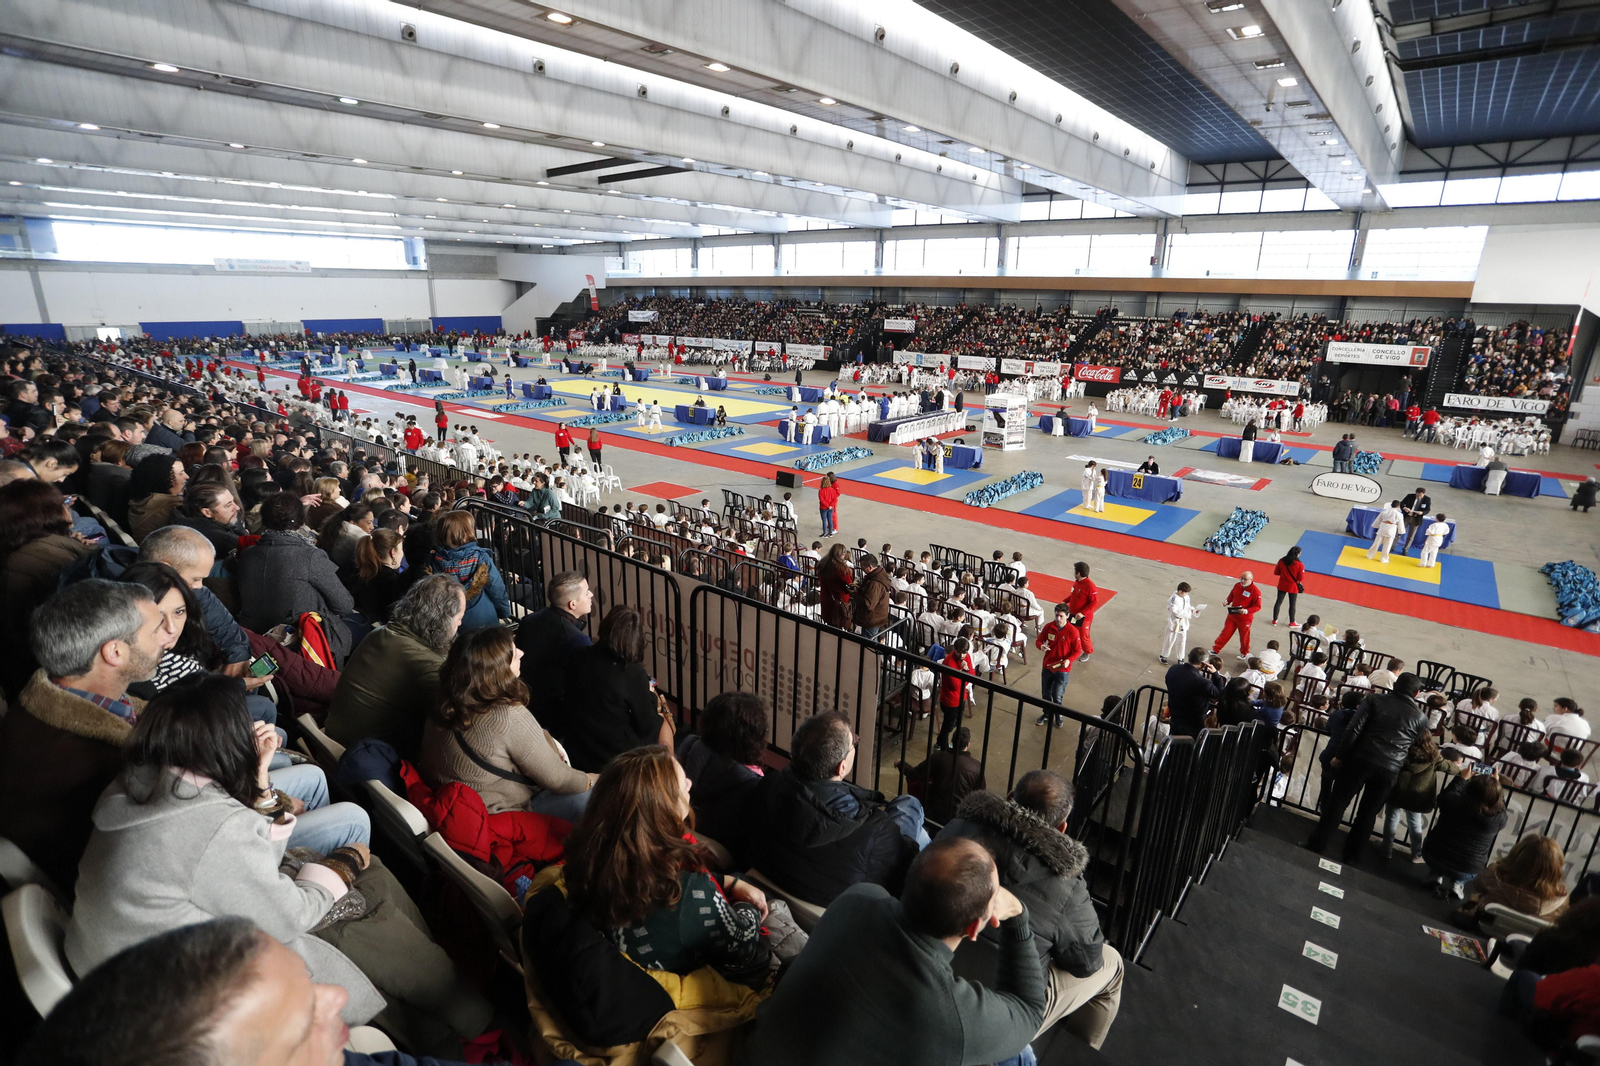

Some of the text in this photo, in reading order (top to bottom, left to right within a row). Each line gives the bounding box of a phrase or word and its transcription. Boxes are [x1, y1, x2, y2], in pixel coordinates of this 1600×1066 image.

[1078, 366, 1116, 381] Coca-Cola
[1447, 395, 1546, 412] FARO DE VIGO
[944, 448, 952, 456] 22
[1133, 478, 1142, 487] 24
[1316, 479, 1339, 488] FARO
[1355, 484, 1378, 494] VIGO
[1312, 910, 1338, 927] 33
[1305, 946, 1335, 967] 34
[1282, 992, 1318, 1017] 35
